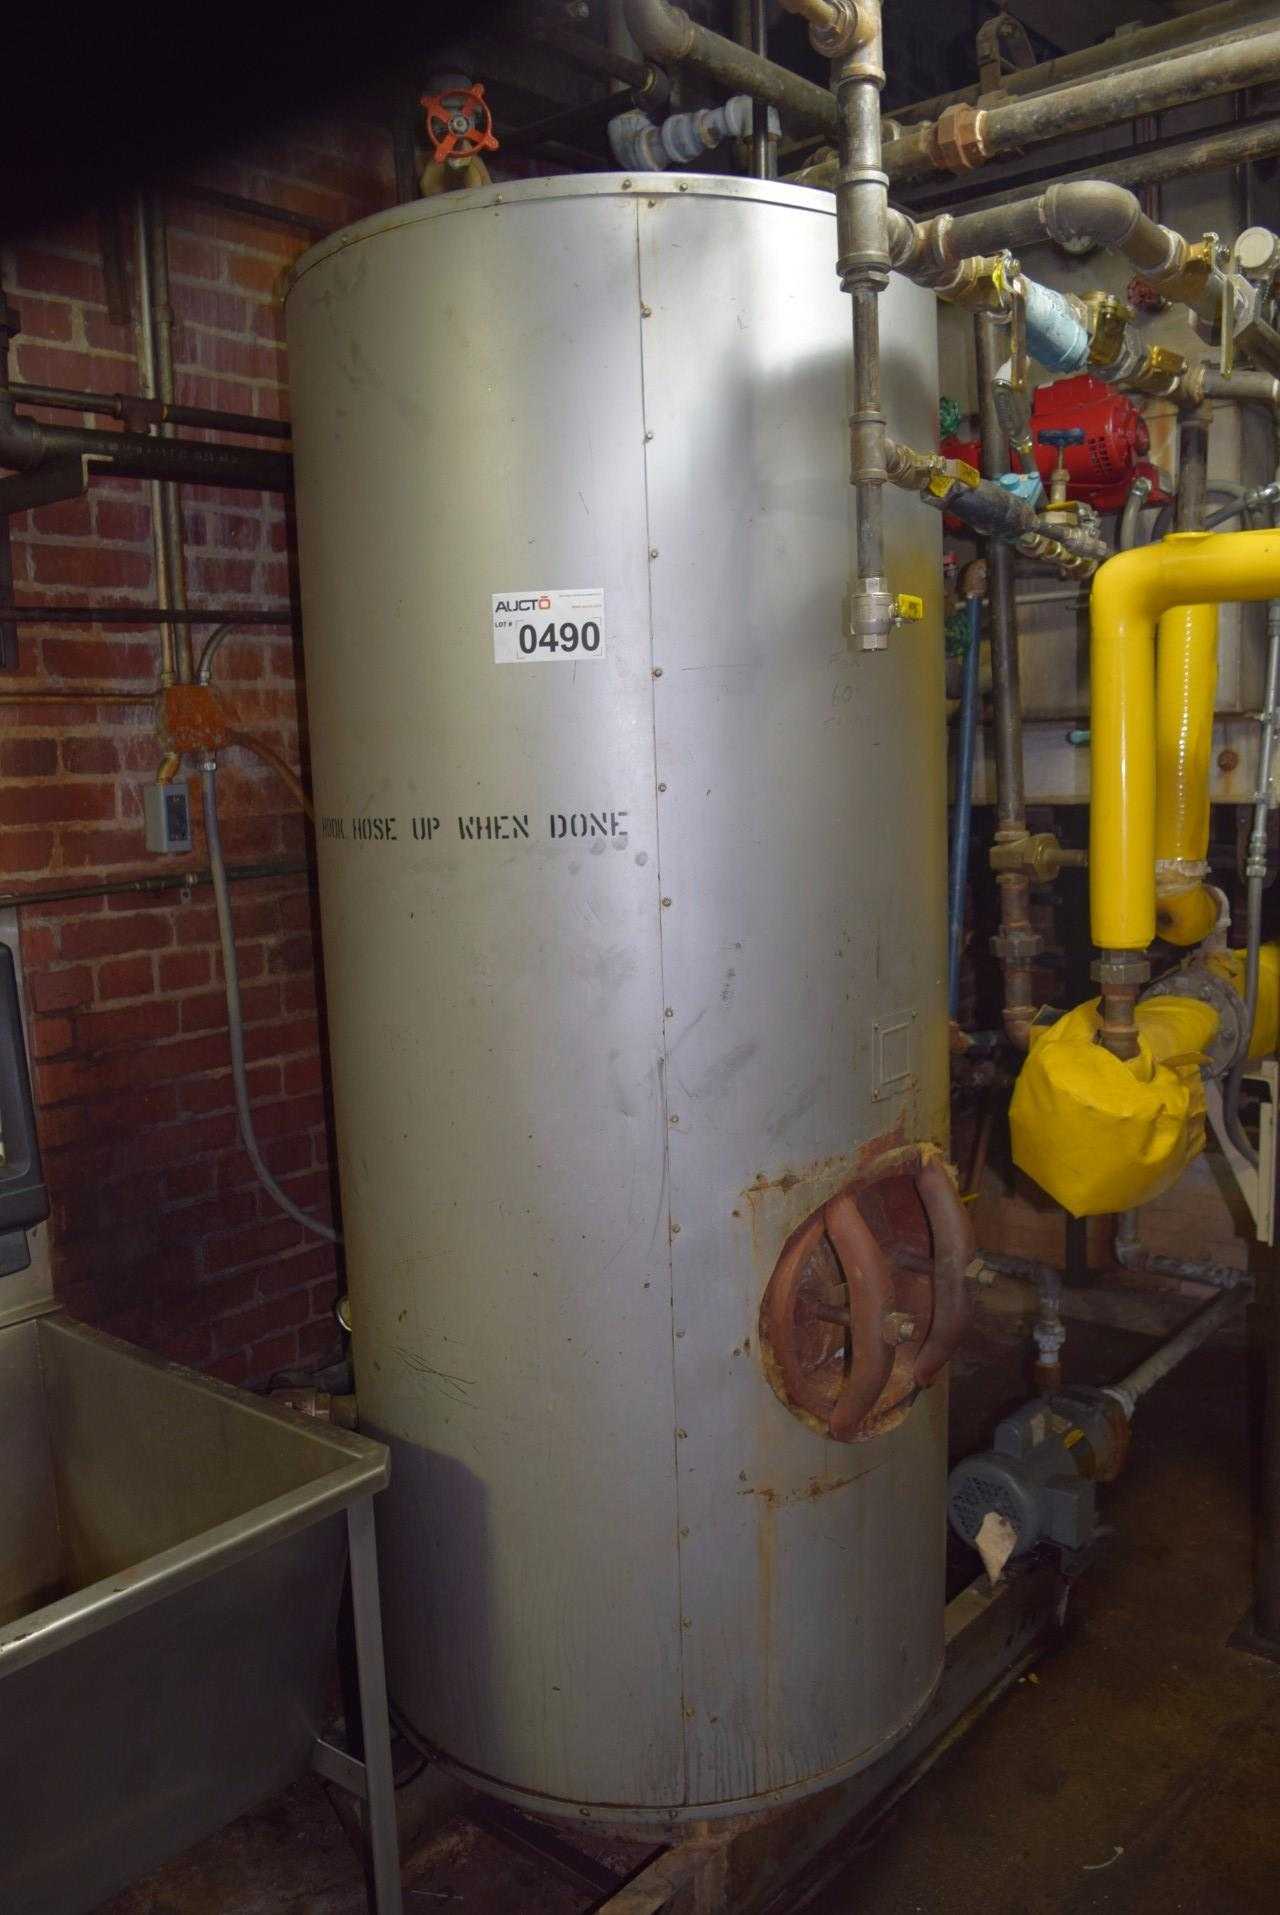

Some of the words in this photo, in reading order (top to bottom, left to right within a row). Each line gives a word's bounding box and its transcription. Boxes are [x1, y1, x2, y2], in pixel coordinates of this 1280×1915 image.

[519, 621, 600, 654] 0490
[353, 817, 397, 840] HOSE
[412, 816, 440, 840] UP
[458, 815, 529, 839] WHEN
[550, 812, 628, 838] DONE
